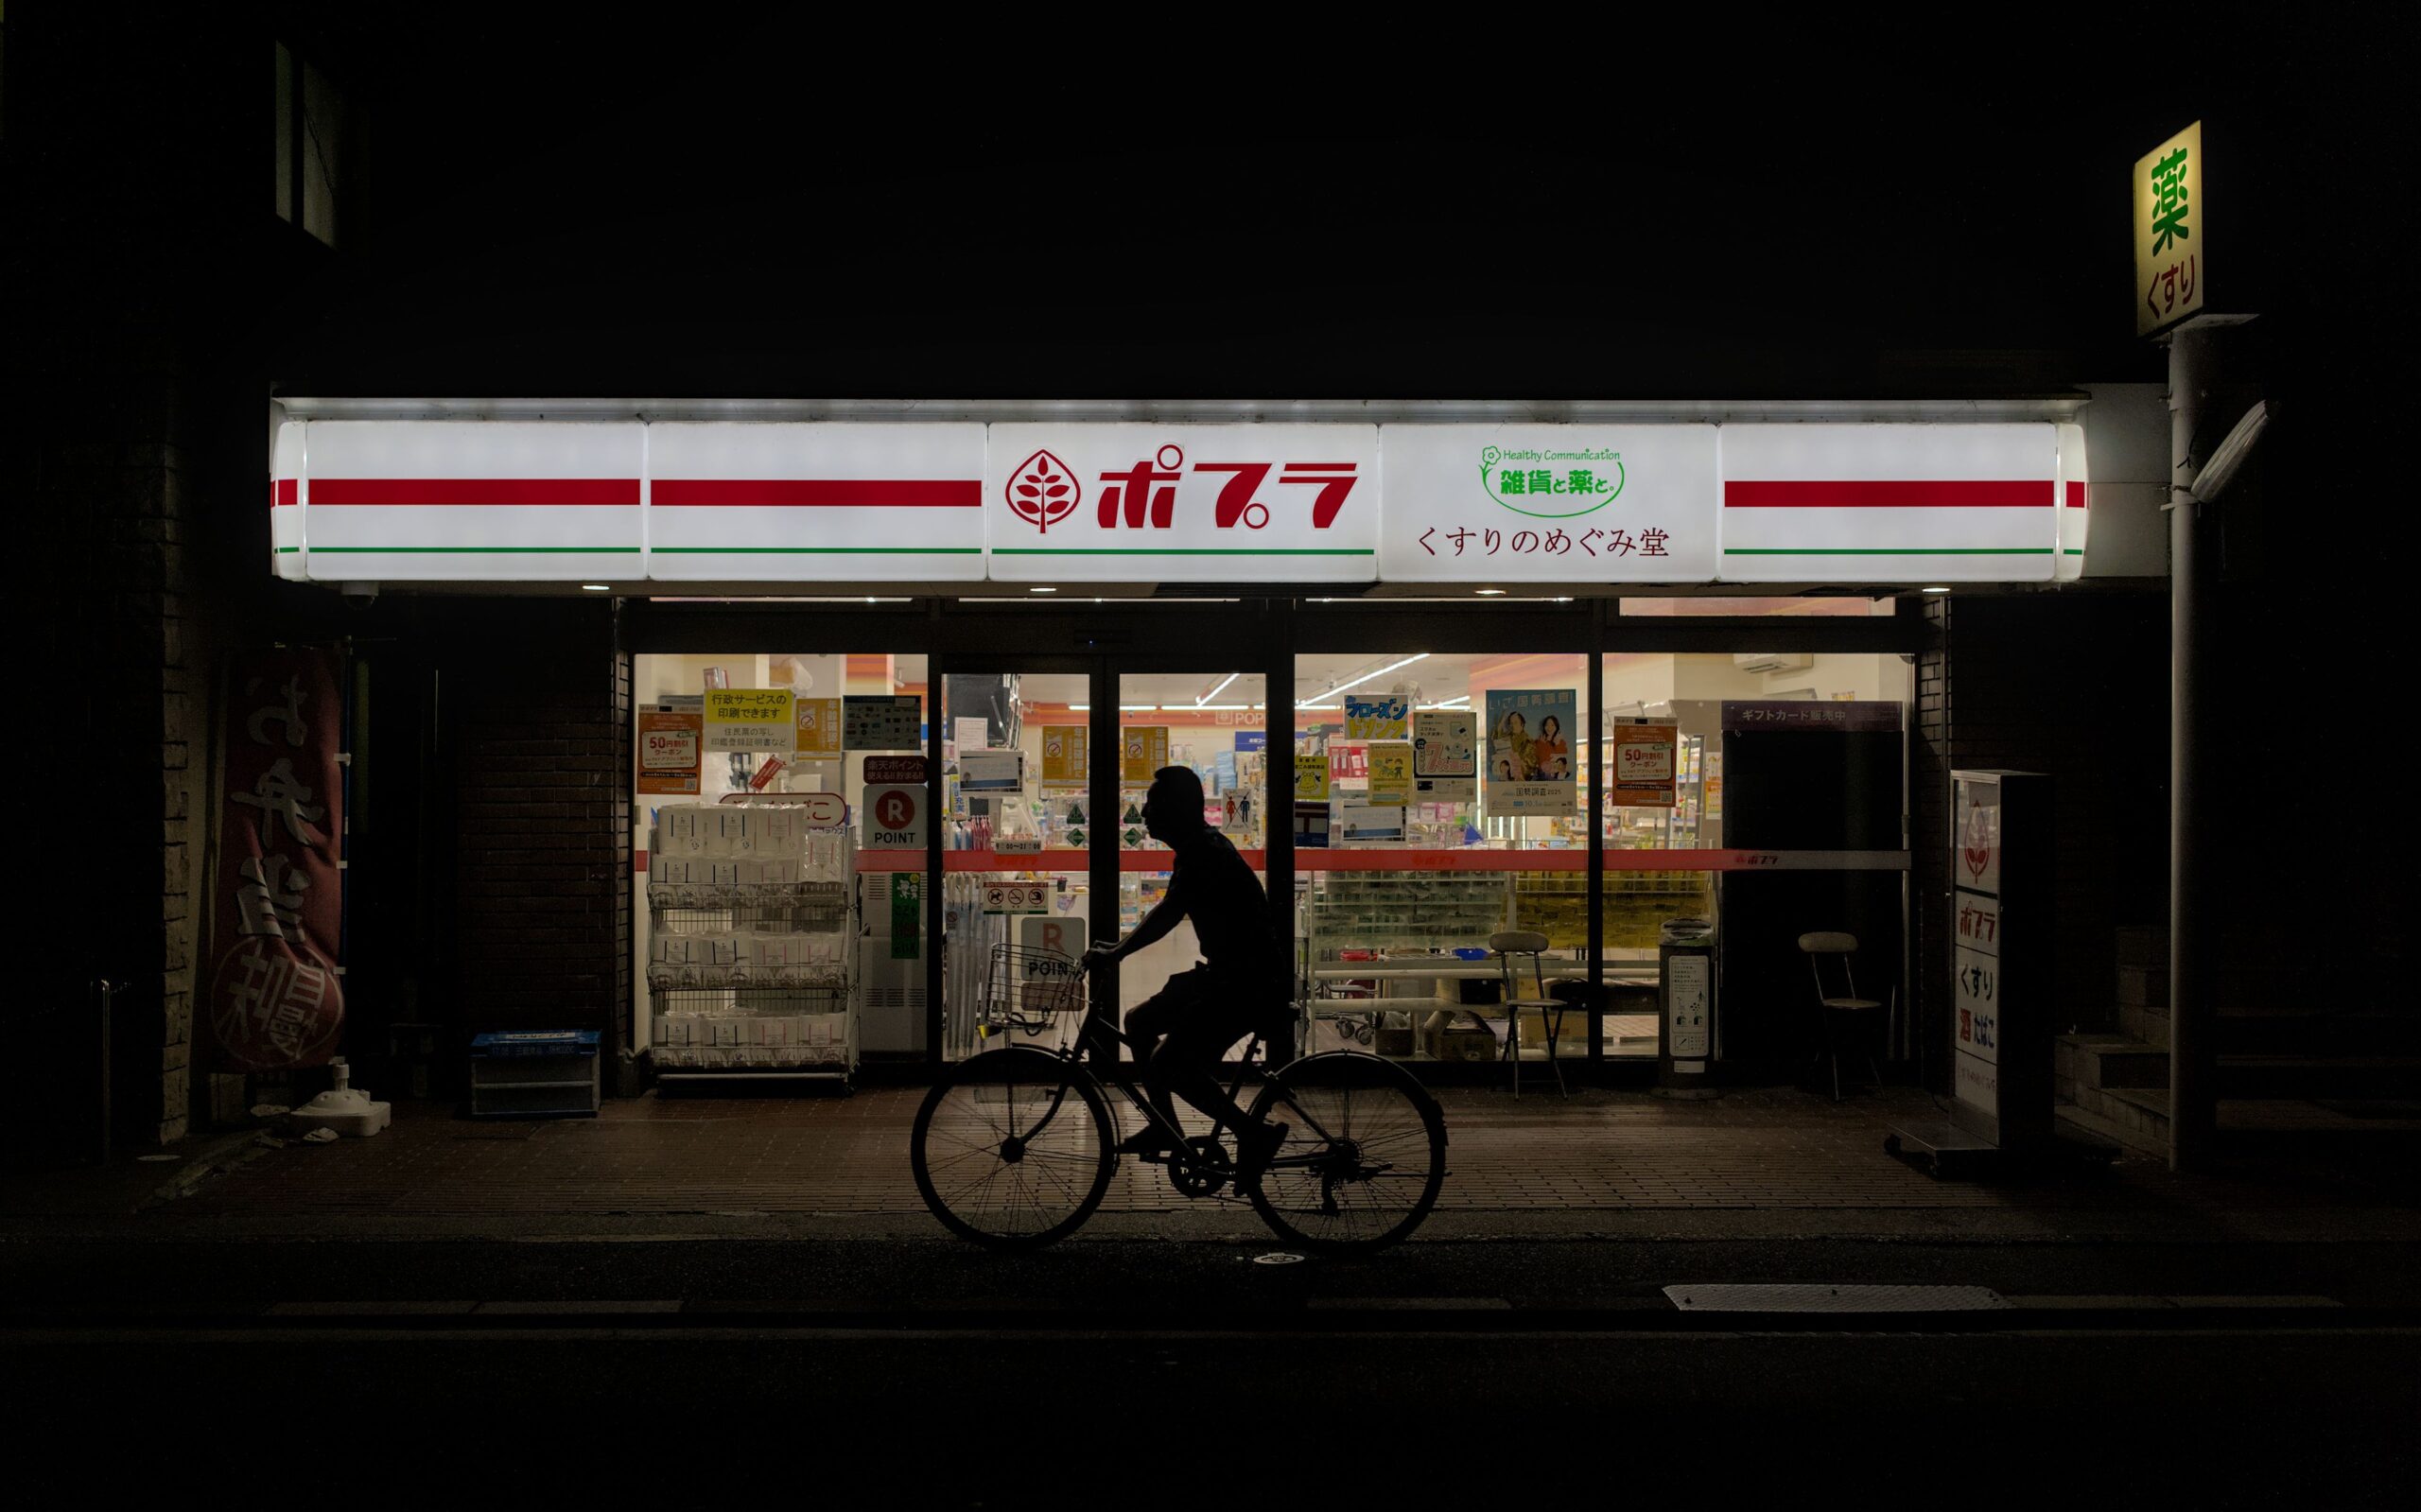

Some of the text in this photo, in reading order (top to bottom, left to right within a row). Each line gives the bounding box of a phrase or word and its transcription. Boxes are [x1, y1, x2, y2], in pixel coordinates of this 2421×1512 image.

[2151, 148, 2189, 257] 薬
[2147, 253, 2195, 320] くすり
[1503, 447, 1620, 461] Healthy Communication
[1097, 444, 1357, 530] ポプラ
[1419, 527, 1669, 557] くすりのめぐみ堂
[711, 693, 787, 704] 行政サービスの
[718, 707, 780, 719] 印刷できます
[1235, 713, 1266, 724] POP
[1346, 698, 1408, 721] フローズン
[1742, 709, 1846, 721] ギフトカード販売中
[649, 737, 688, 749] 50円割引
[1625, 748, 1664, 761] 50円割引
[868, 760, 924, 771] 楽天ポイント
[887, 799, 906, 822] R
[874, 832, 915, 843] POINT
[1959, 900, 1995, 943] ポプラ
[1042, 923, 1066, 952] R
[1028, 962, 1081, 976] POIN
[1960, 964, 1994, 1000] くすり
[1974, 1012, 1995, 1050] たばこ
